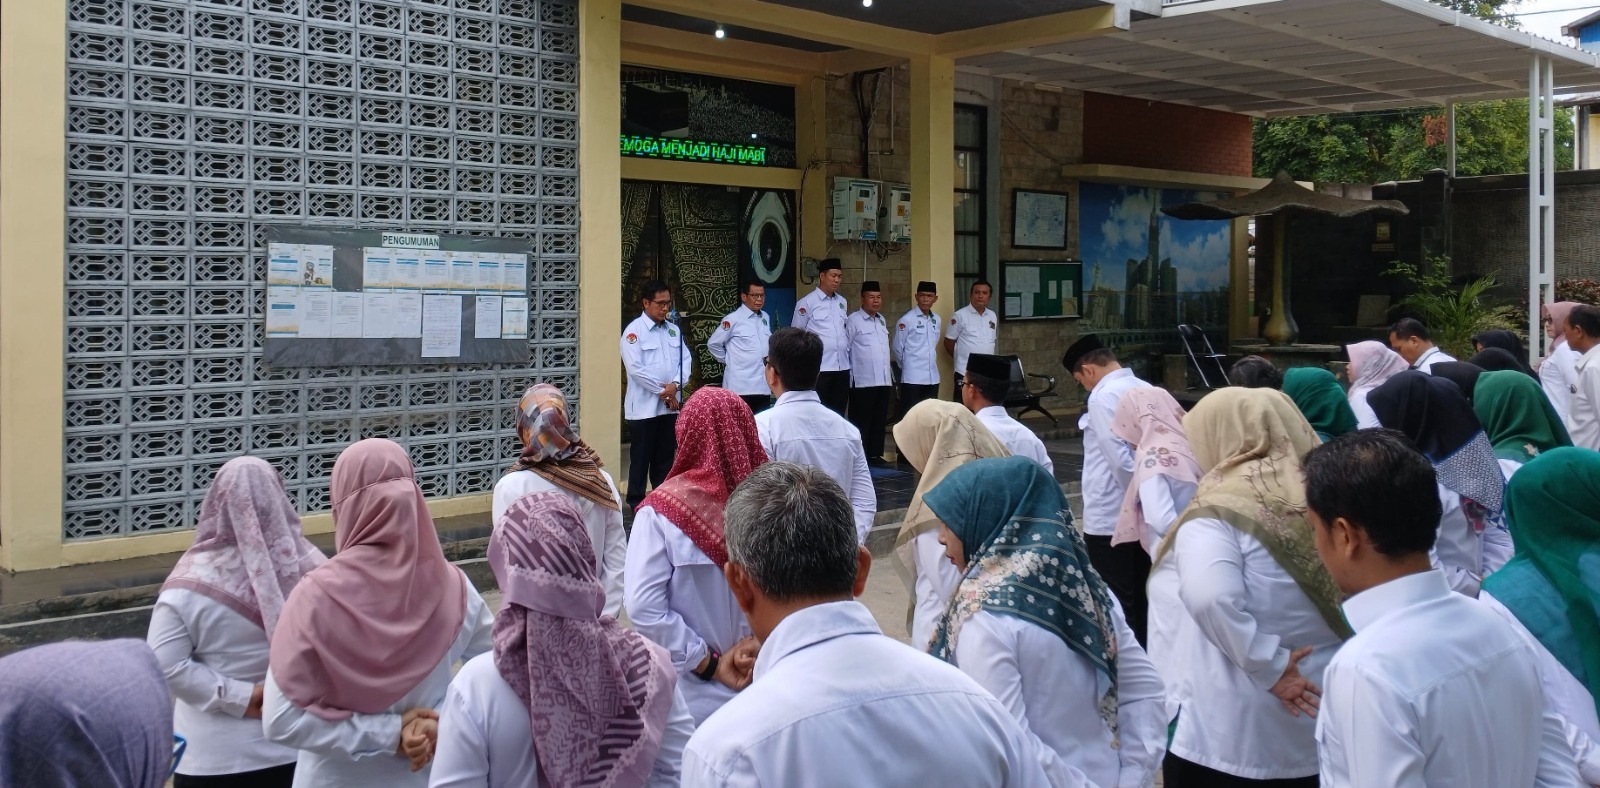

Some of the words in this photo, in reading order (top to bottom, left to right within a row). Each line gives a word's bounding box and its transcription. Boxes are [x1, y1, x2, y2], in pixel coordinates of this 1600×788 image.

[661, 141, 710, 157] MENJADI
[712, 146, 736, 159] HAJI
[382, 236, 439, 246] PENGUMUMAN
